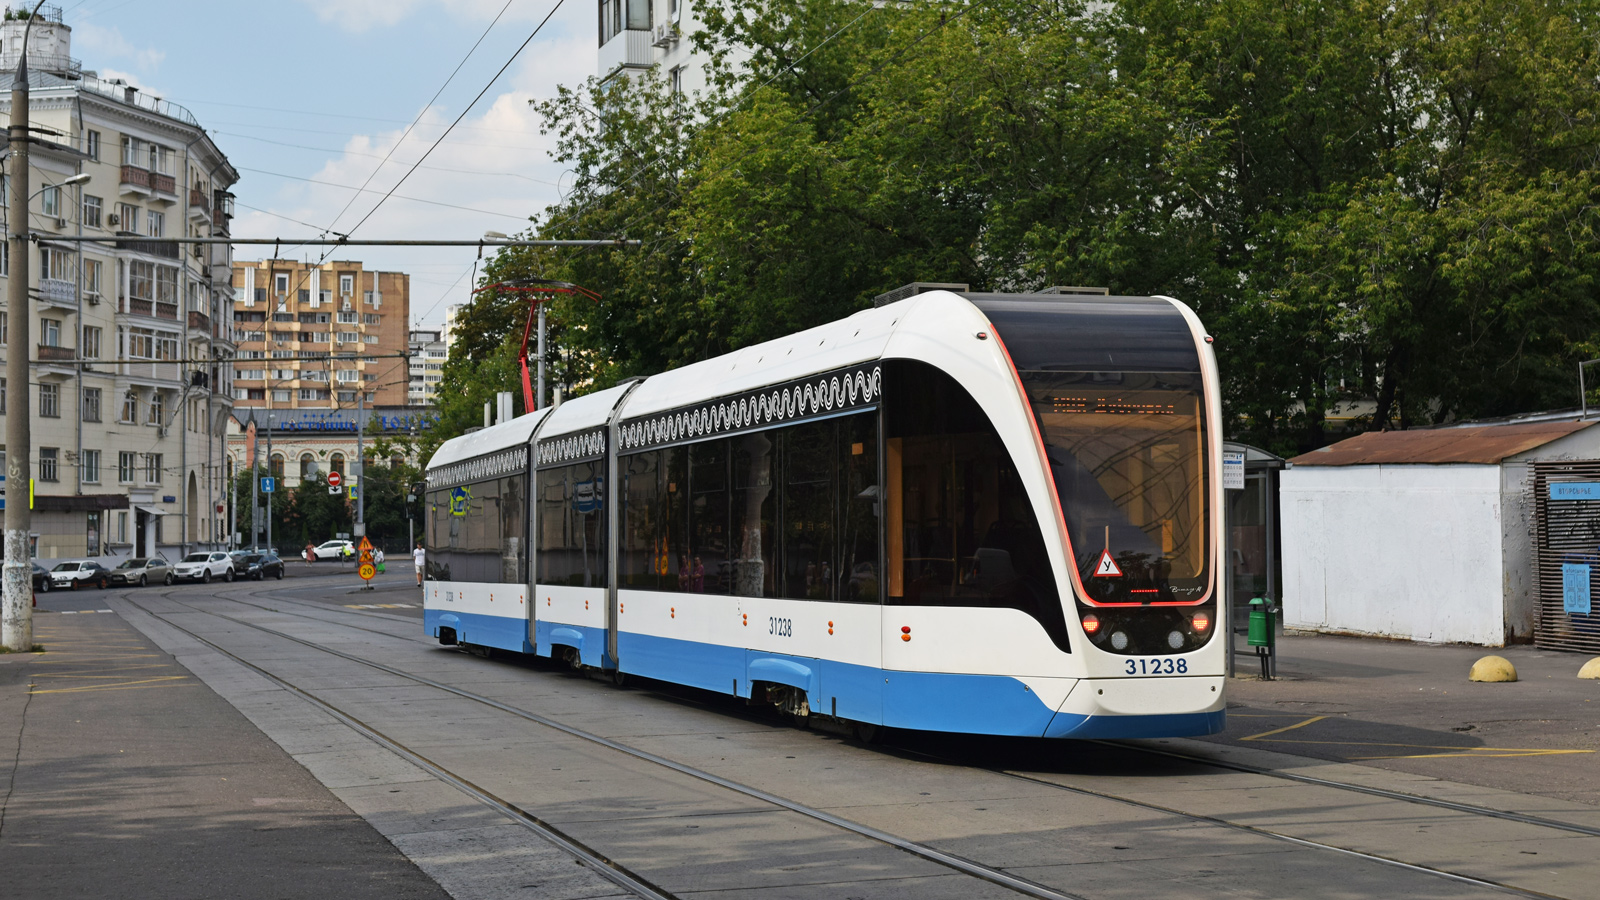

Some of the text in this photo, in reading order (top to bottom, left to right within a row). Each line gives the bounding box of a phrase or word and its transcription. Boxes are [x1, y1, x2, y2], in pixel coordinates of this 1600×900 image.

[362, 568, 373, 576] 20
[769, 616, 792, 638] 31238
[1125, 658, 1188, 675] 31238
